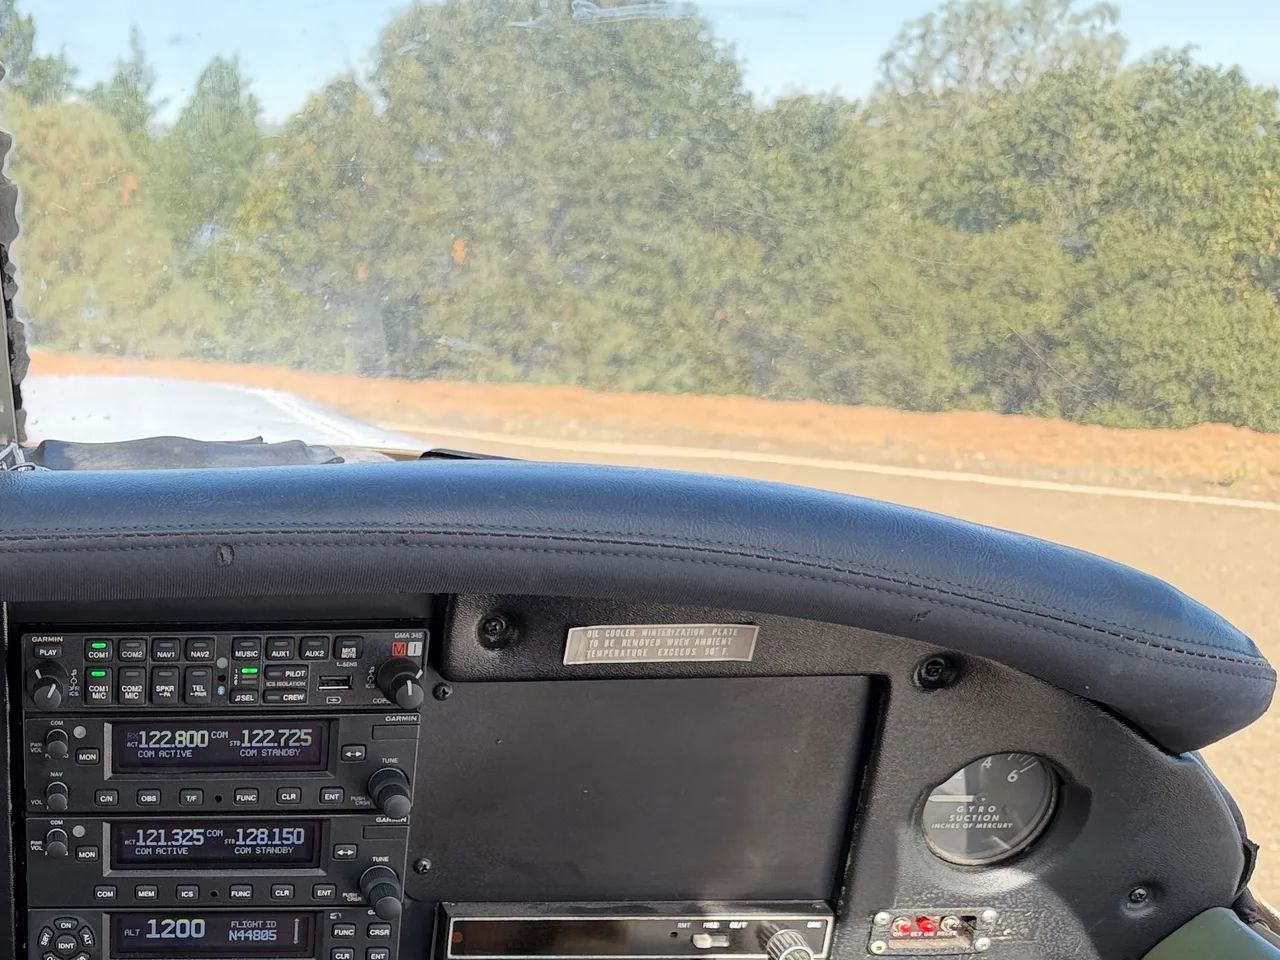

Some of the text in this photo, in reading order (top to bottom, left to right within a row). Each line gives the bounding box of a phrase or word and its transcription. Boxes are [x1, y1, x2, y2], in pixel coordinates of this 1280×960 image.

[587, 628, 738, 638] OIL COOLER WINTERIZATION PLATE
[604, 639, 614, 647] BE
[622, 638, 660, 647] REMOVED
[667, 638, 689, 646] WHEN
[694, 638, 732, 646] AMBIENT
[235, 650, 258, 658] MUSIC
[586, 648, 696, 658] TEMPERATURE EXCEEDS
[285, 670, 306, 678] PILOT
[138, 729, 312, 748] 122.800 COM 122.725
[138, 750, 154, 758] COM
[159, 750, 192, 758] ACTIVE
[262, 749, 301, 757] STANDBY
[236, 794, 256, 802] FUNC
[949, 814, 1000, 822] SUCTION
[136, 828, 305, 846] 121.325 COM 128.150
[146, 918, 206, 939] 1200
[228, 930, 278, 941] N44805
